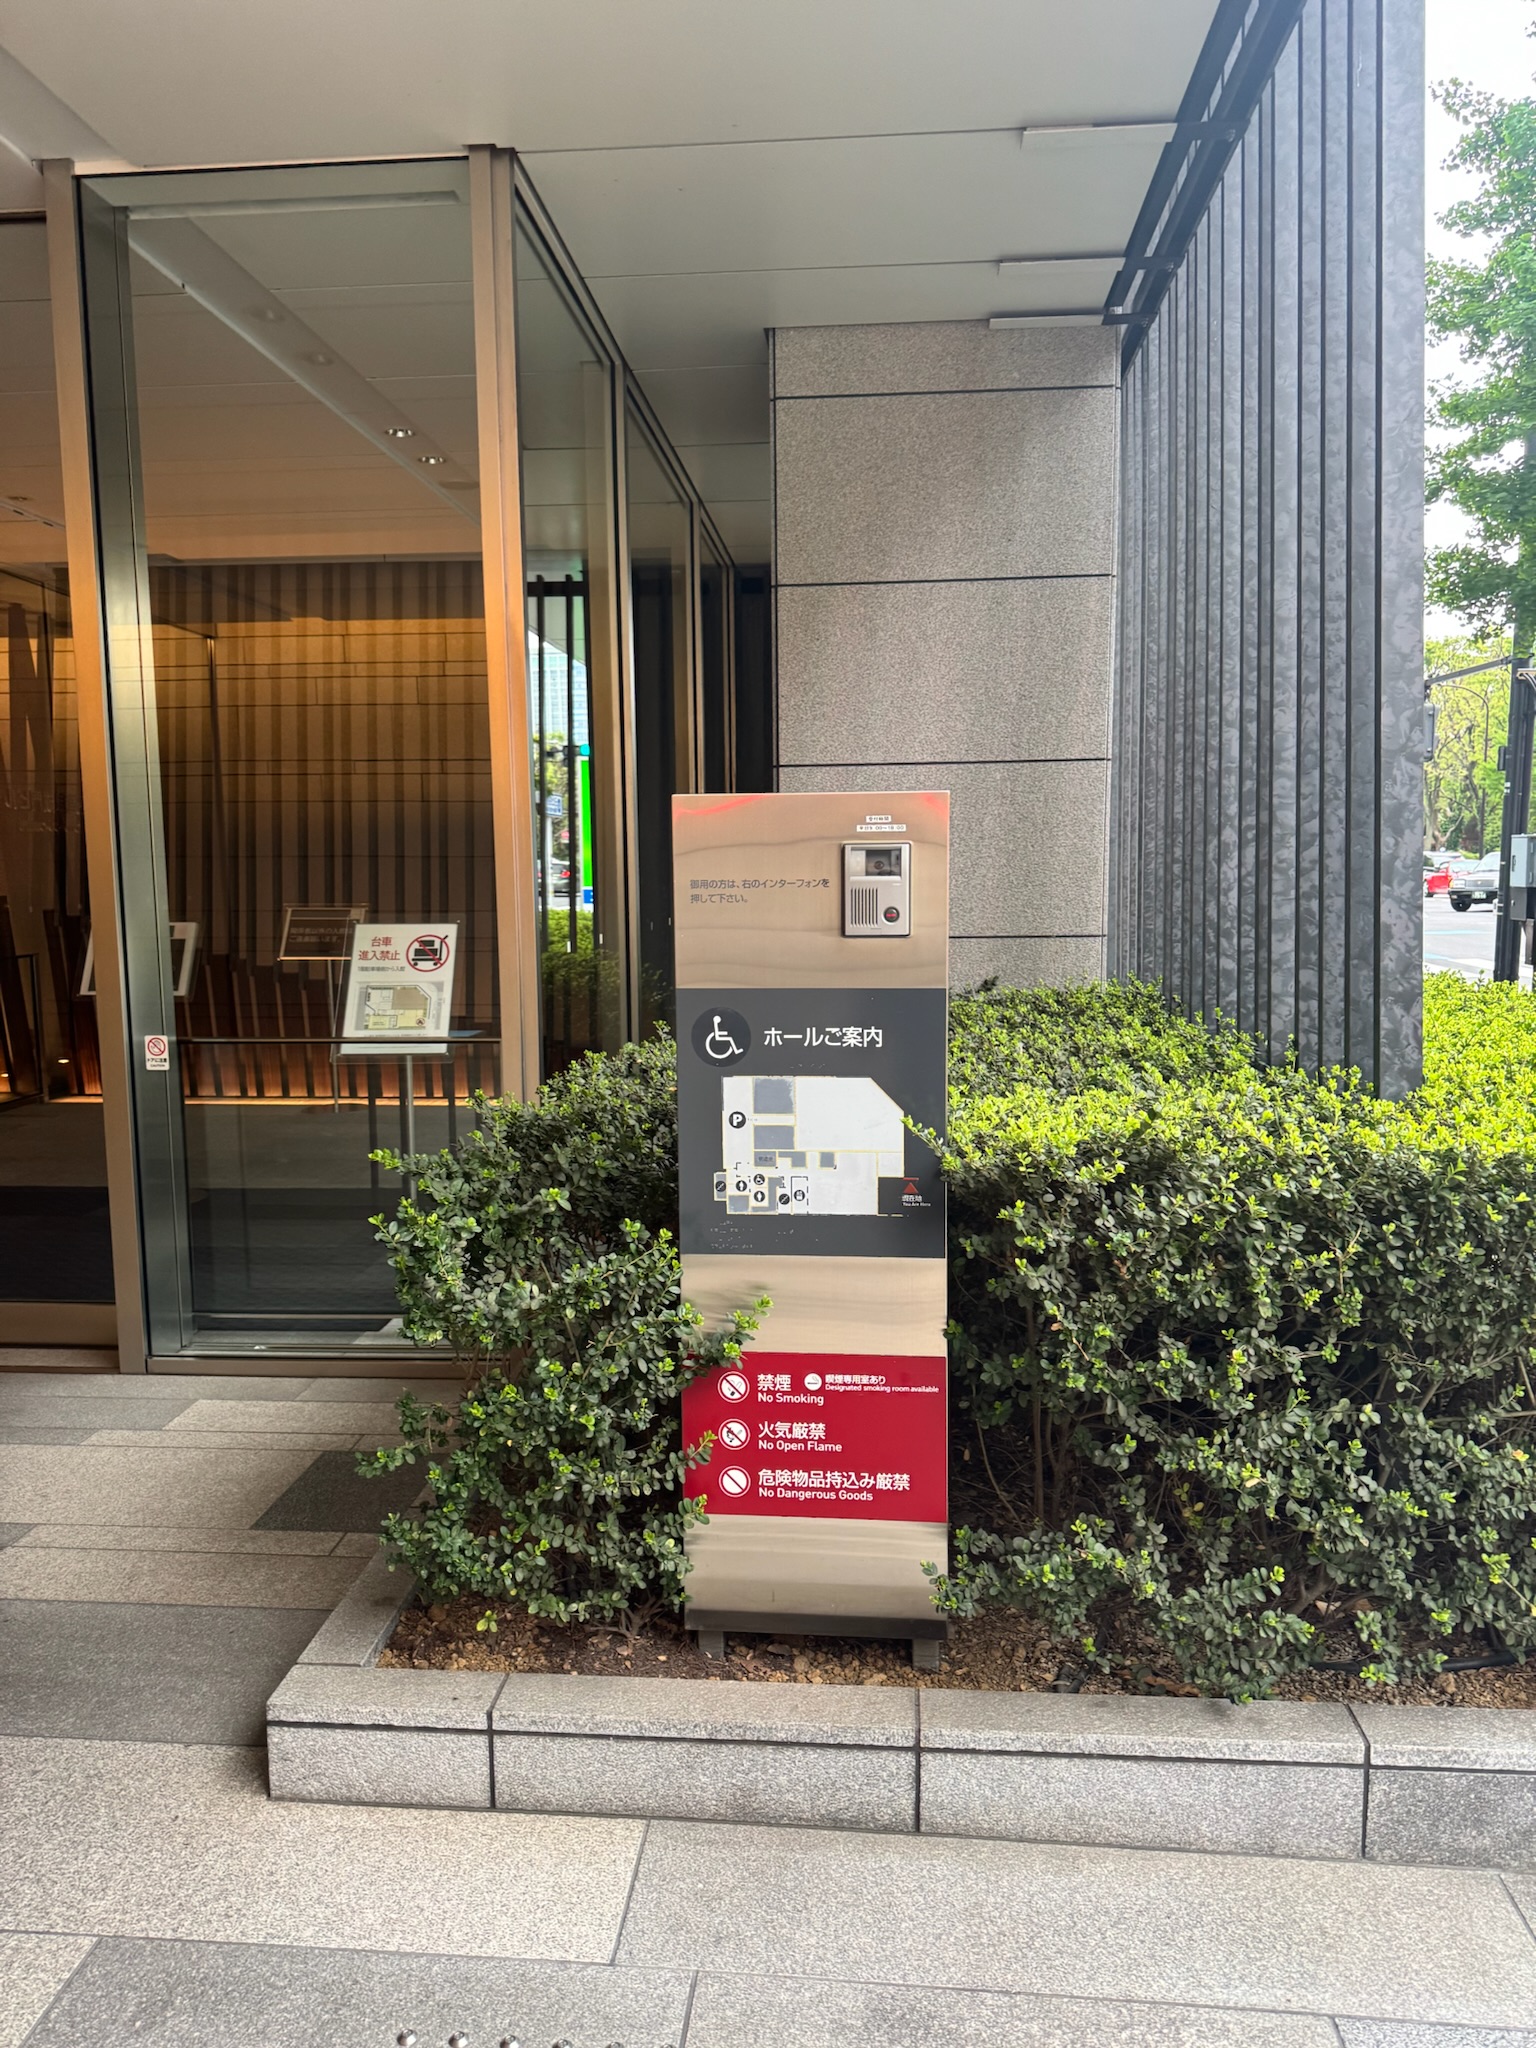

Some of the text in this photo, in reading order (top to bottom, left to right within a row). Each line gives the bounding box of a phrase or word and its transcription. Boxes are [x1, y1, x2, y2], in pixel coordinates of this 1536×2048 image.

[690, 878, 830, 889] 御用の方は、右のインターフォンを
[690, 893, 748, 904] 押して下さい。
[371, 936, 393, 947] 台車
[358, 950, 401, 961] 進入禁止
[763, 1026, 883, 1048] ホールご案内
[757, 1374, 792, 1391] 禁煙
[825, 1374, 886, 1384] 喫煙専用室あり
[825, 1384, 862, 1392] Designated
[863, 1385, 891, 1393] smoking
[758, 1392, 824, 1406] No Smoking
[758, 1420, 826, 1440] 火気厳禁
[758, 1440, 843, 1453] No Open Flame
[758, 1469, 911, 1491] 危険物品持込み厳禁
[758, 1488, 874, 1501] No Dangerous Goods
